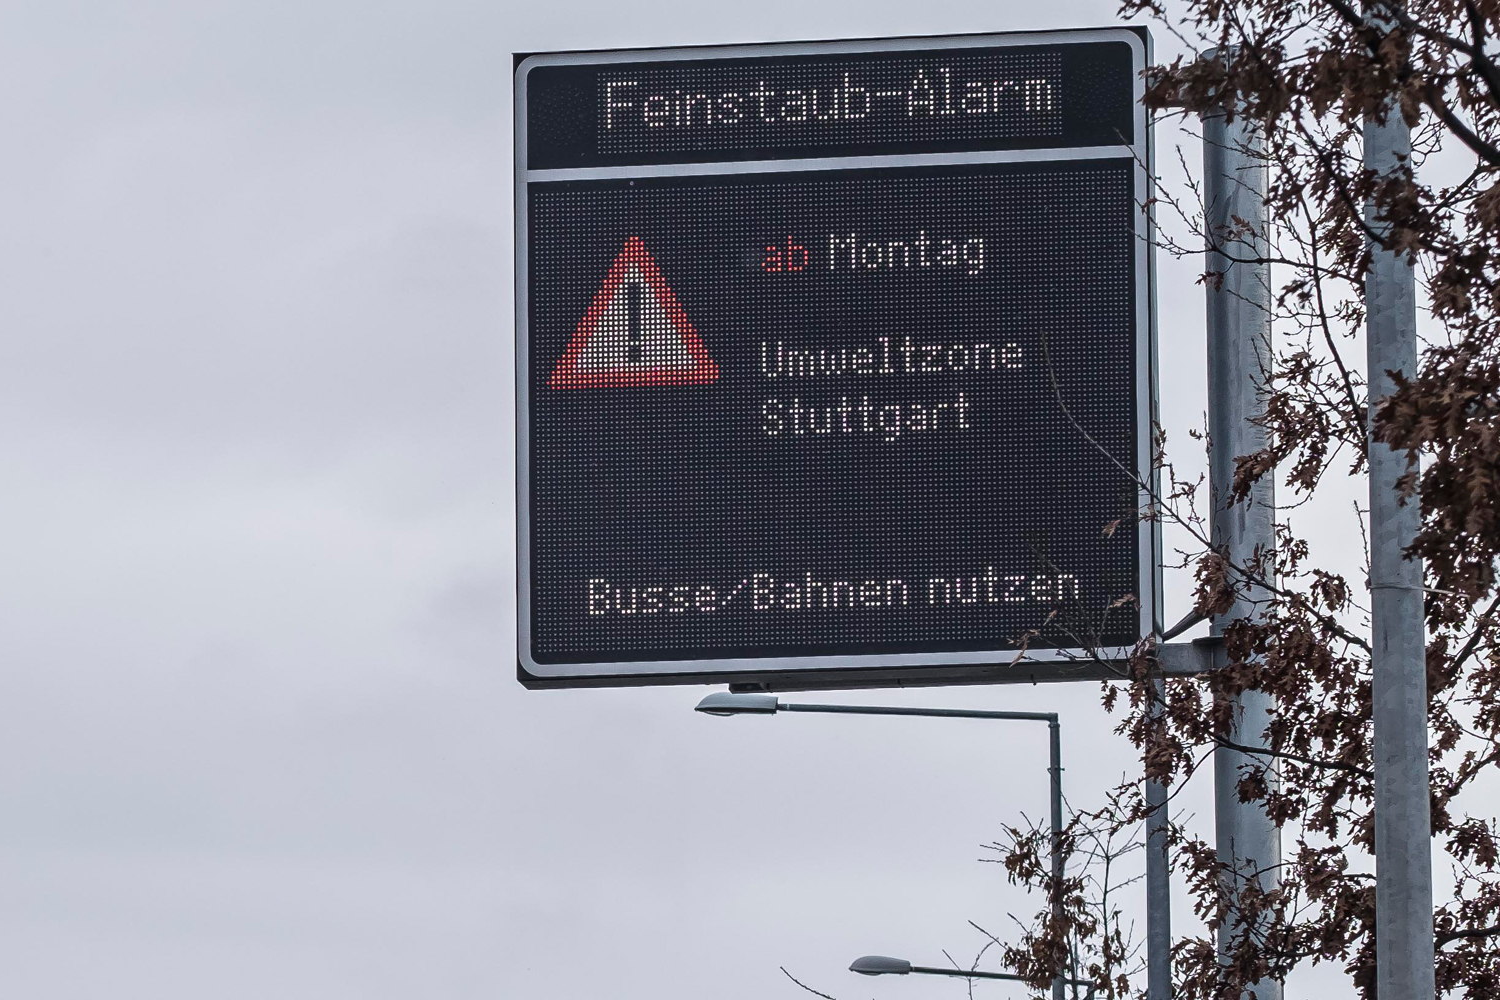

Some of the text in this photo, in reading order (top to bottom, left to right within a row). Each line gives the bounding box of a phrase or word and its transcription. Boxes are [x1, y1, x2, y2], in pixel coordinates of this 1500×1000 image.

[605, 68, 1053, 130] Feinstaub-Alarm
[762, 231, 985, 274] ab Montag
[761, 337, 1023, 378] Umweltzone
[762, 392, 970, 441] Stuttgart
[588, 566, 1080, 616] Busse/Bahnen nutzen
